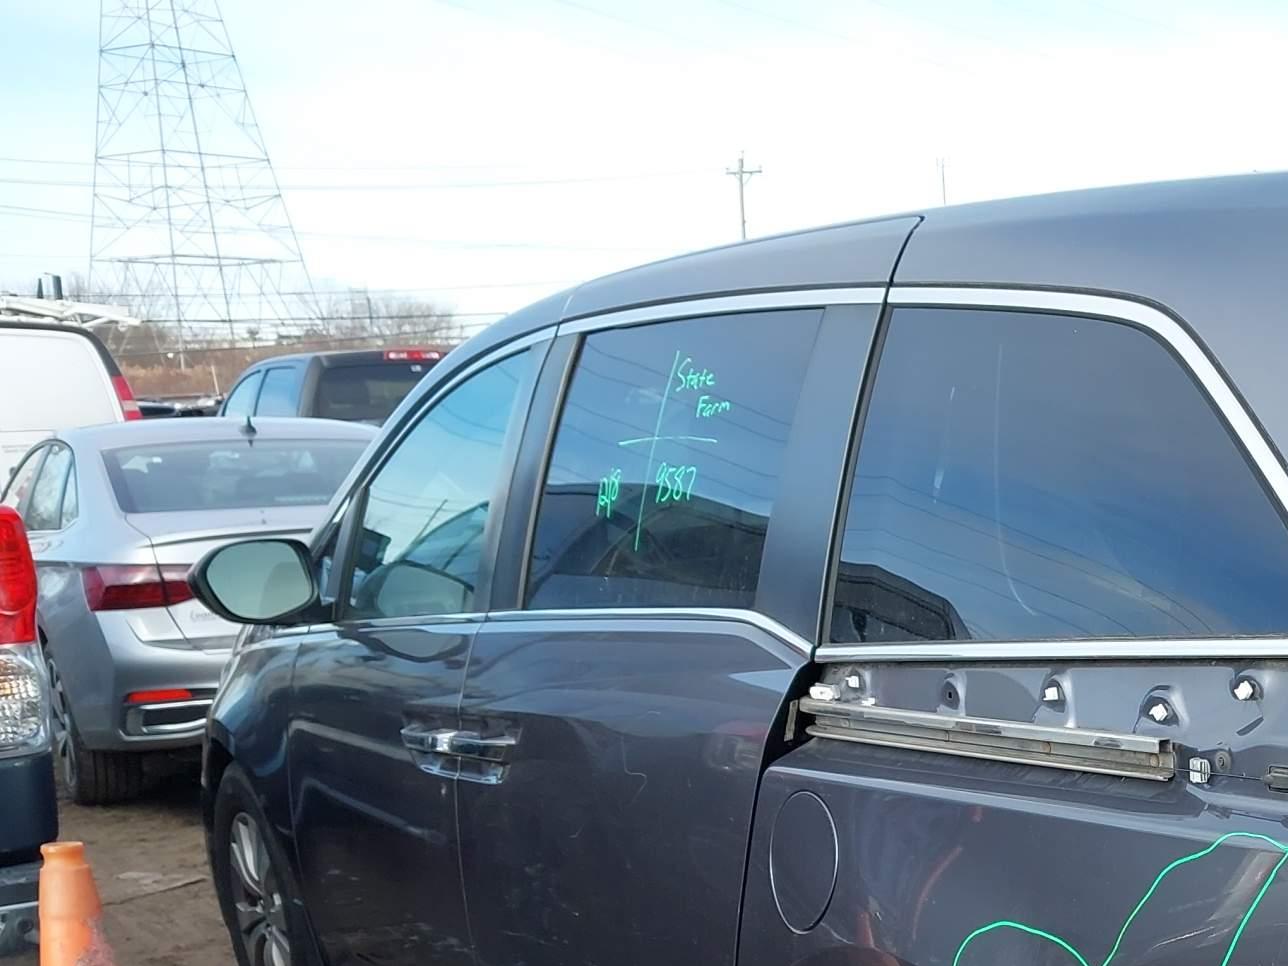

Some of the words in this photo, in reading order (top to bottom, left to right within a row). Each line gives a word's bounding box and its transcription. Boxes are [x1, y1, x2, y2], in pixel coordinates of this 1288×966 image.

[675, 357, 715, 392] State
[696, 395, 730, 418] Farm
[655, 461, 697, 503] 9587
